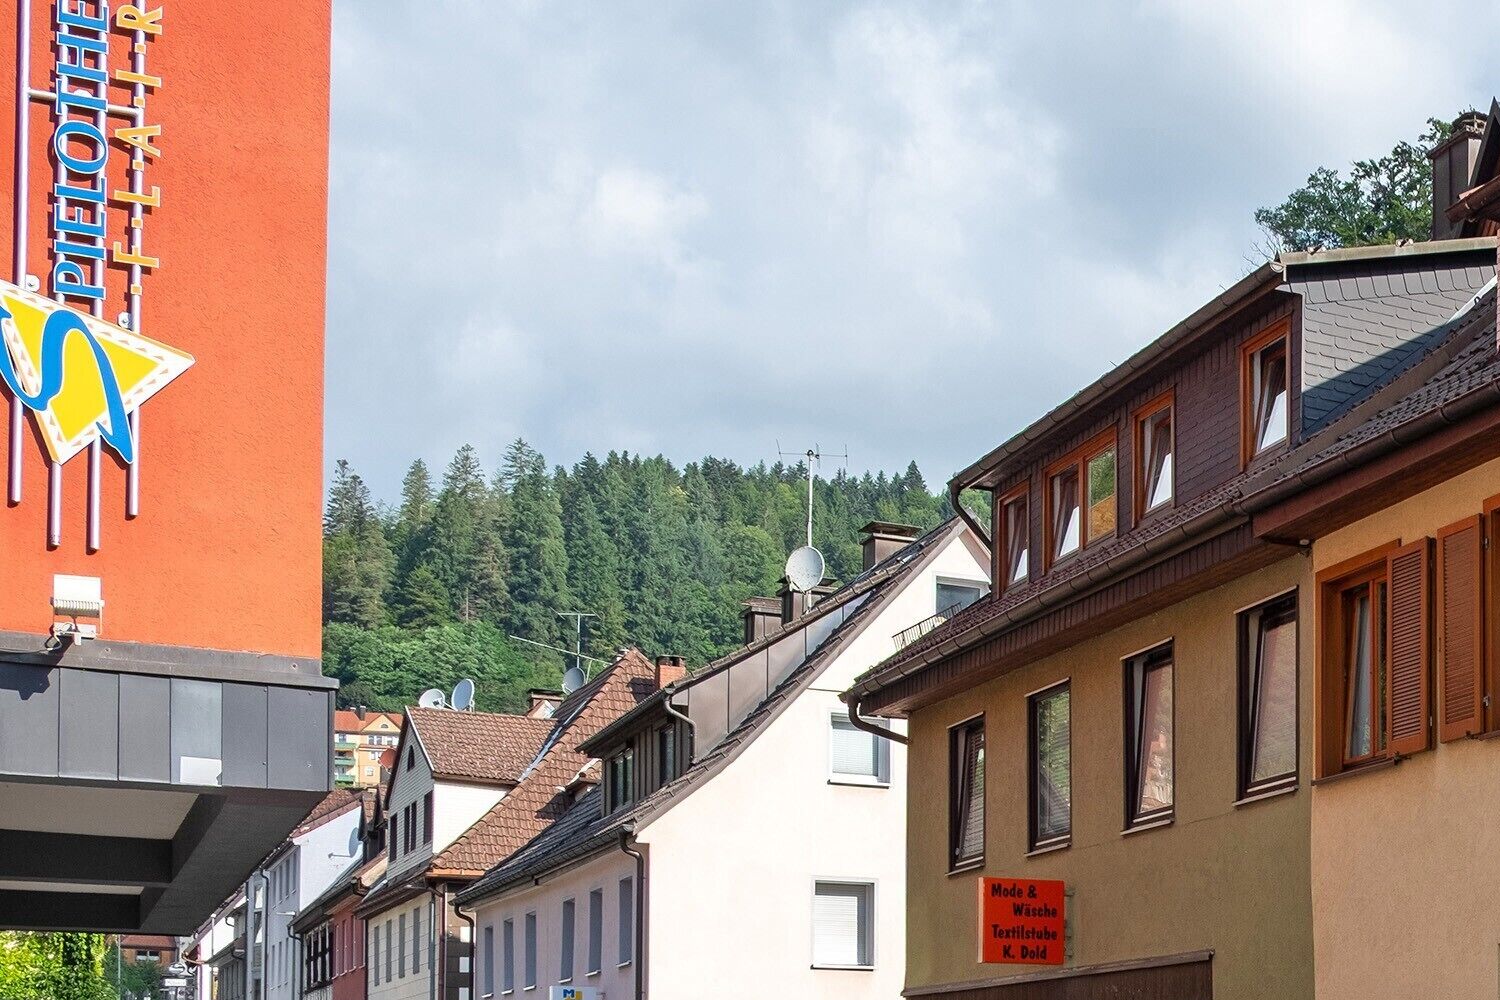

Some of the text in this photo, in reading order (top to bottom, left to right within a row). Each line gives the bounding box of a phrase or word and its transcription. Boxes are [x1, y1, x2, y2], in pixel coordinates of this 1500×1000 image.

[991, 883, 1037, 898] Mode &
[1013, 902, 1058, 918] Wäsche
[992, 924, 1058, 940] Textilstube
[1003, 944, 1047, 960] K. Dold
